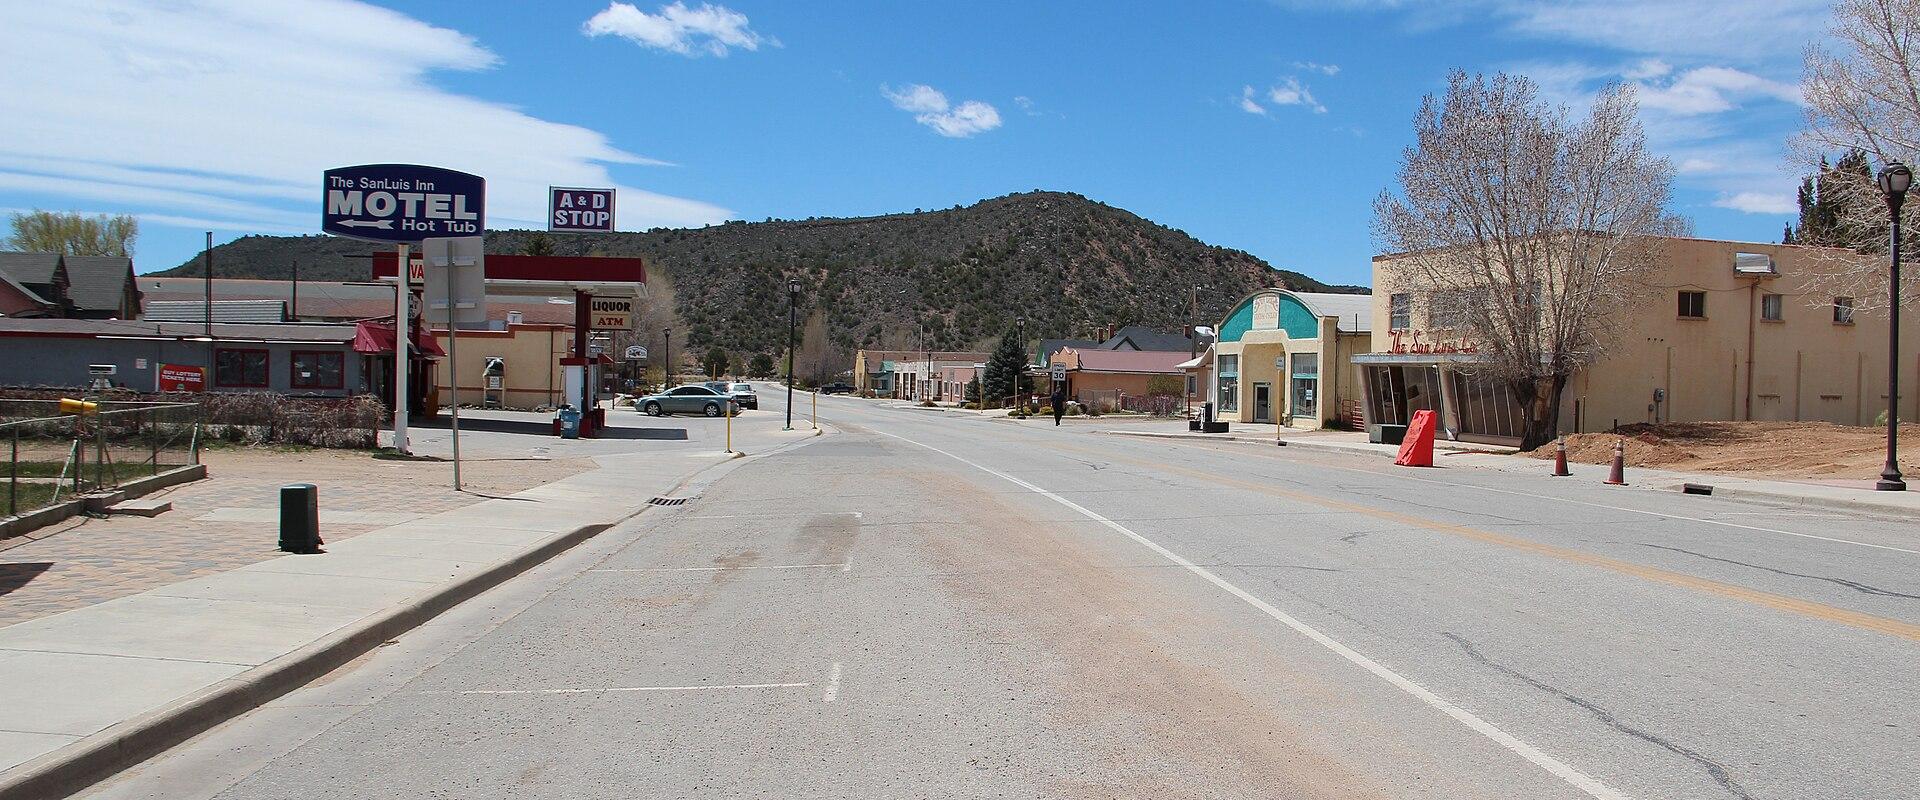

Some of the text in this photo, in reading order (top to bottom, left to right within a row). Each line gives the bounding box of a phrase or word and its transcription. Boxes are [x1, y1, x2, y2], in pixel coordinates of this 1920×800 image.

[330, 176, 435, 191] The SanLuis Inn
[328, 189, 478, 220] MOTEL
[560, 192, 606, 209] A & D
[402, 218, 477, 233] Hot Tub
[554, 209, 610, 227] STOP
[410, 264, 424, 279] VA
[592, 300, 631, 312] LIQUOR
[597, 317, 624, 327] ATM
[1387, 330, 1407, 354] The
[1410, 329, 1430, 354] San
